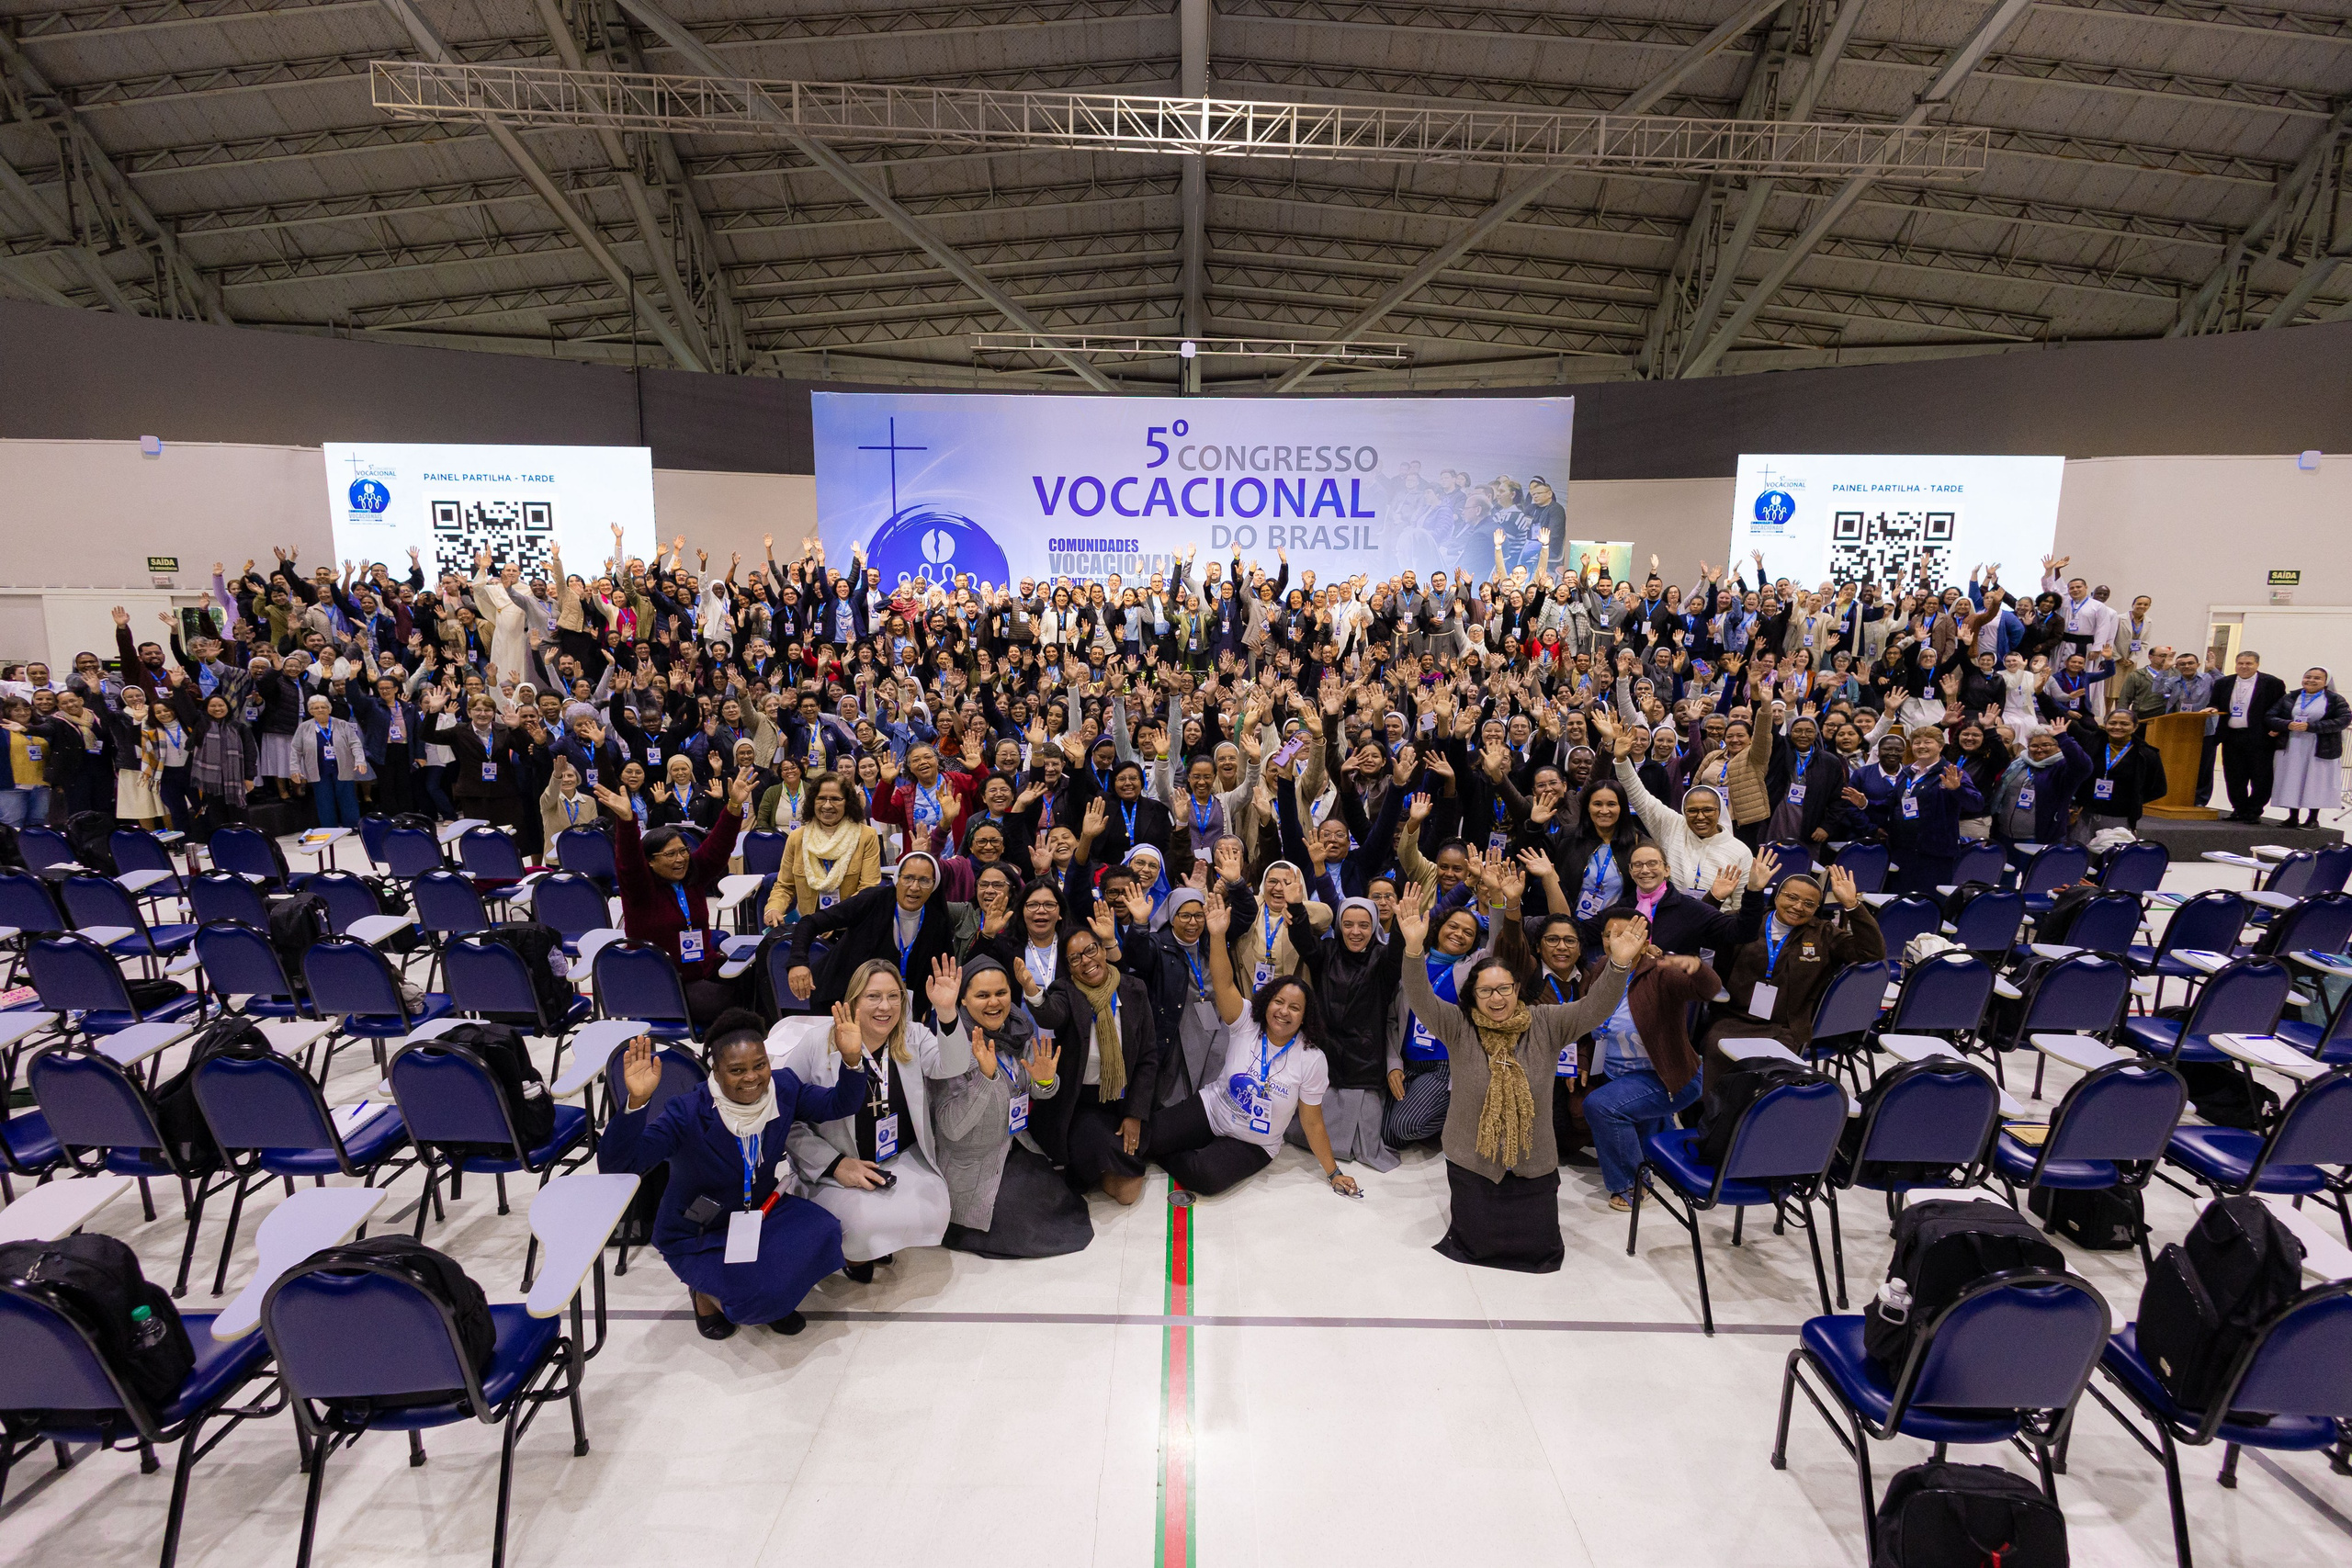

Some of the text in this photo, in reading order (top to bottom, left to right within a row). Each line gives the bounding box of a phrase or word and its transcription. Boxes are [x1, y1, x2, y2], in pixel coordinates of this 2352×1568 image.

[1146, 419, 1379, 472] 5º CONGRESSO
[1871, 484, 1920, 492] PARTILHA
[1032, 475, 1375, 518] VOCACIONAL
[1211, 525, 1379, 550] DO BRASIL
[1048, 538, 1139, 552] COMUNIDADES
[151, 557, 175, 565] SAÍDA
[2271, 570, 2297, 579] SAÍDA
